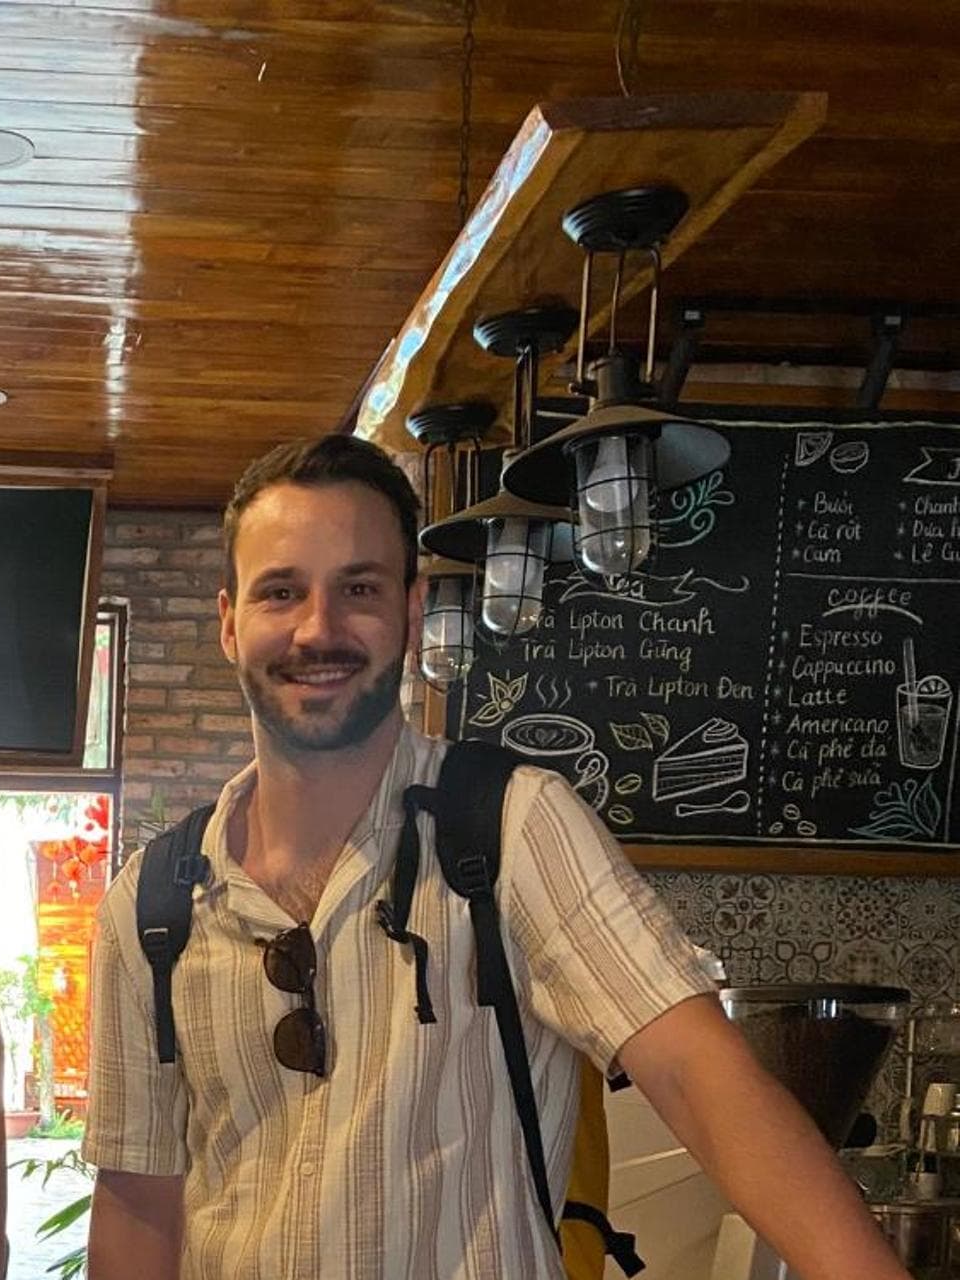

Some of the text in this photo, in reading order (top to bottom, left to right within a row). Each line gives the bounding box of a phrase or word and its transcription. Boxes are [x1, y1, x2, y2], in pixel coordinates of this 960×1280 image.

[803, 544, 842, 563] Cam
[569, 607, 624, 641] Lipton
[640, 606, 716, 635] Chanh
[568, 637, 626, 669] Lipton
[800, 623, 883, 655] Espresso
[792, 654, 896, 685] Cappuccino
[648, 675, 709, 705] Lipton
[788, 685, 848, 708] Latte
[786, 713, 889, 735] Americano
